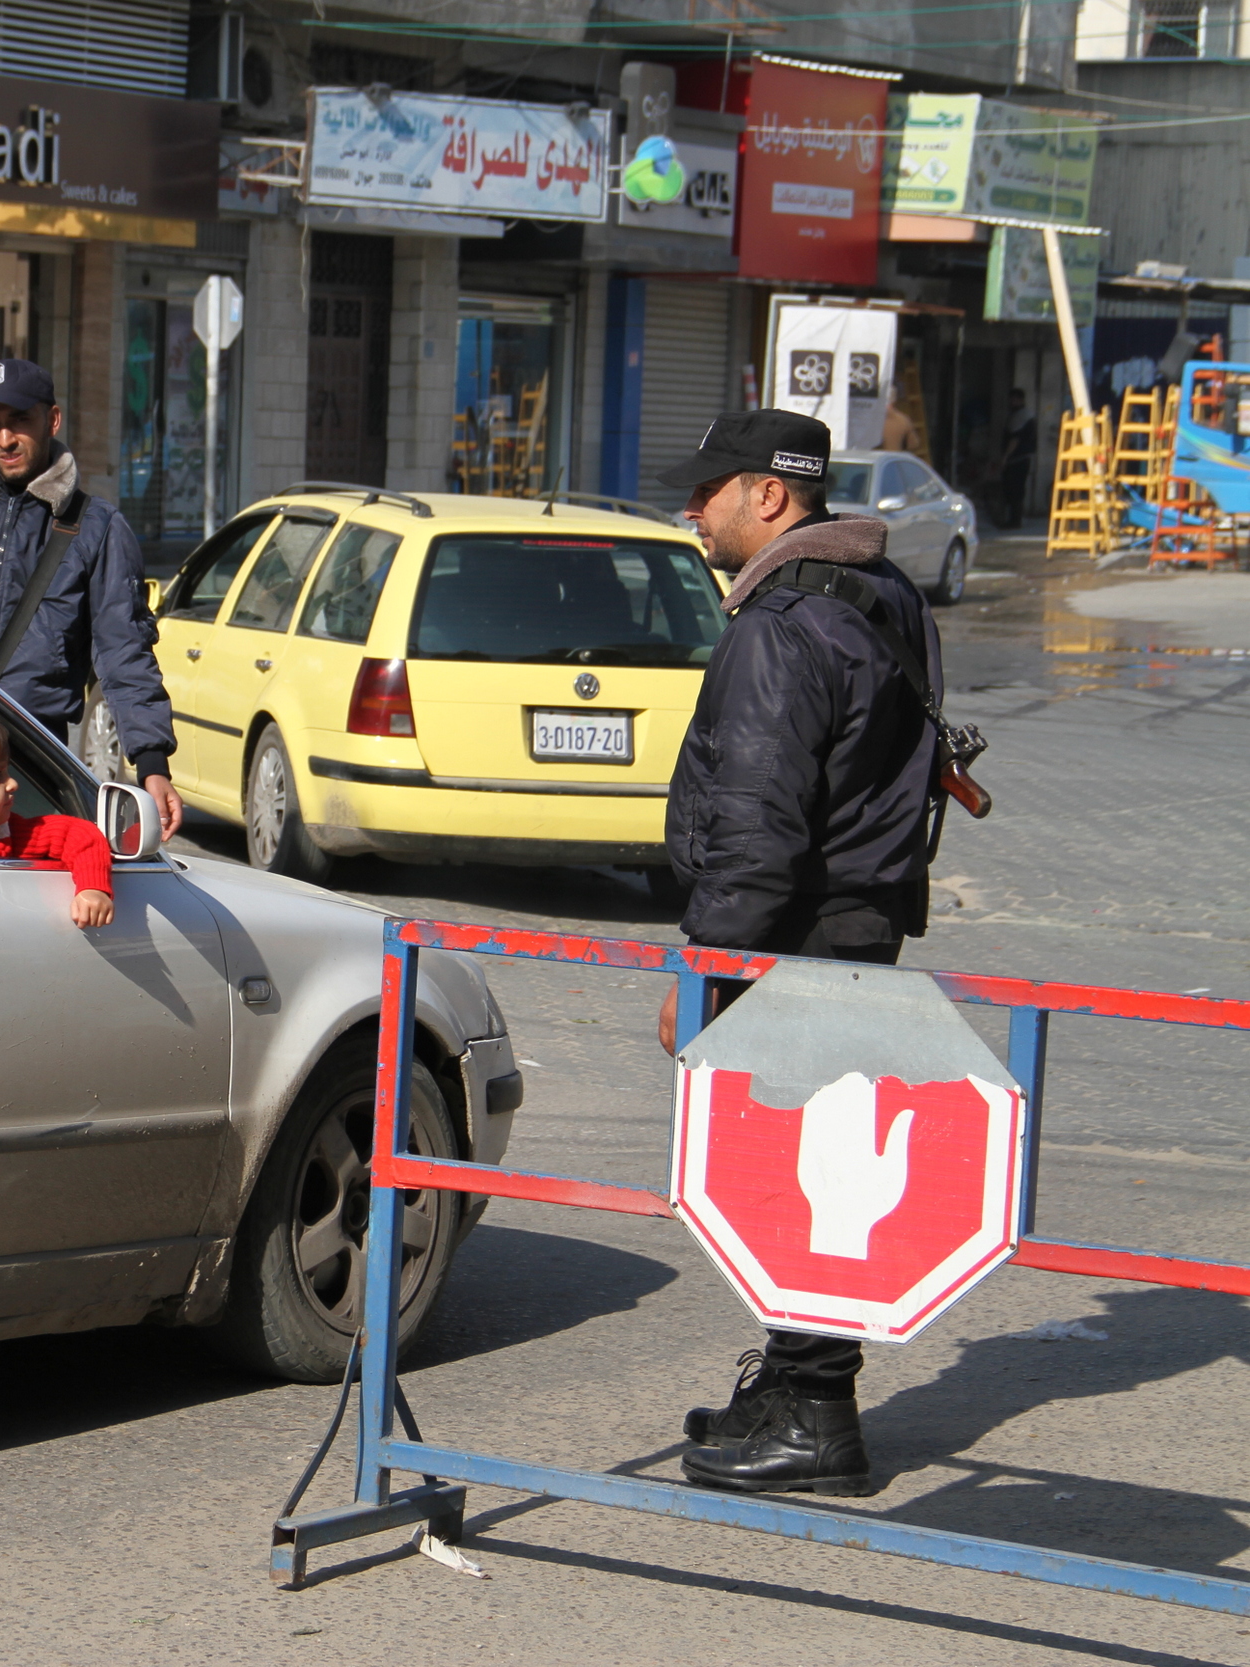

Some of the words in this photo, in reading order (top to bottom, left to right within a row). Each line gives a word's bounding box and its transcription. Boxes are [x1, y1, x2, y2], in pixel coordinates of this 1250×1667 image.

[442, 114, 531, 191] للصرافة
[754, 110, 799, 156] موبايل
[802, 117, 854, 161] الوطنية
[60, 179, 96, 202] Sweets
[98, 184, 108, 203] &
[109, 186, 138, 207] cakes
[538, 726, 623, 752] 3-0187-20
